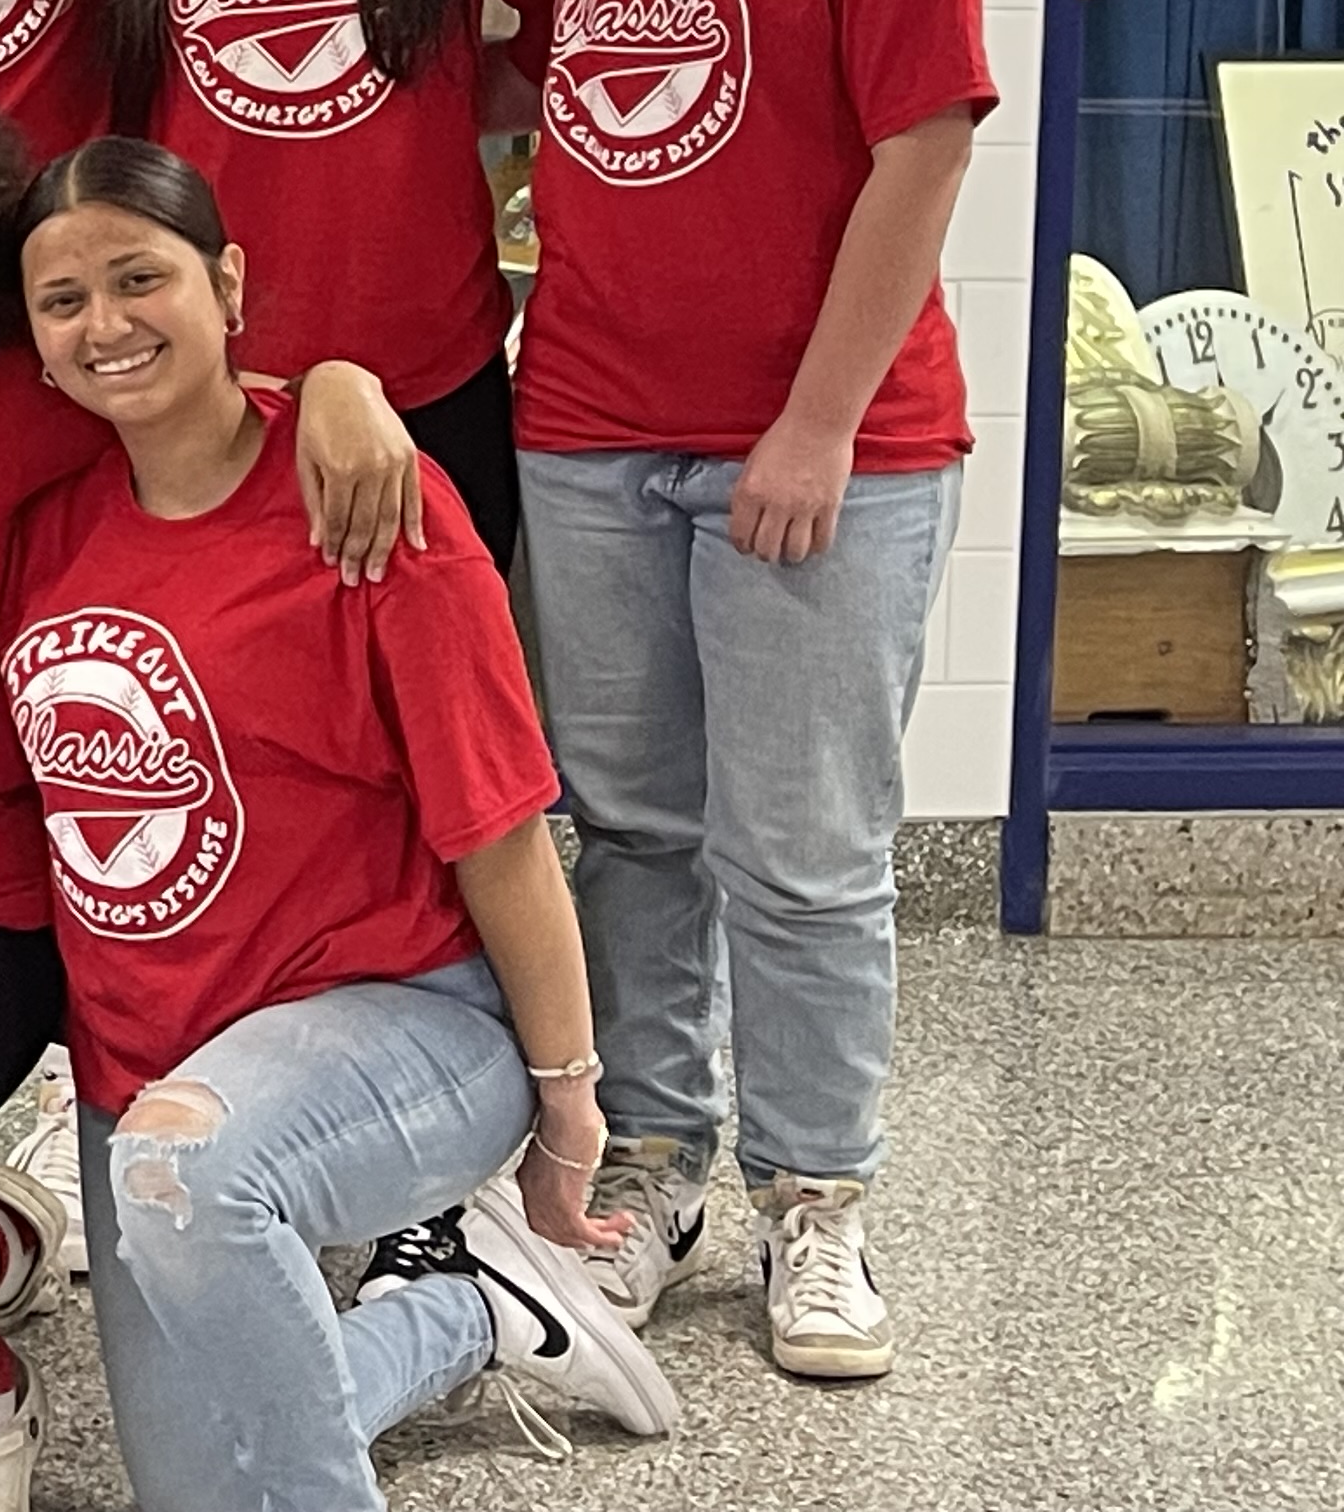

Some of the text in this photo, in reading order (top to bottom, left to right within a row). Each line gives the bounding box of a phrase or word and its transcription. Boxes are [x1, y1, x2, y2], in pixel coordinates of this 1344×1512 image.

[184, 45, 219, 88] LOU
[214, 88, 335, 127] GEHRIG'S
[1185, 319, 1216, 364] 12
[1251, 328, 1267, 369] 1
[1296, 366, 1324, 409] 2
[1328, 431, 1344, 472] 3
[7, 620, 197, 723] STRIKE OUT
[149, 816, 229, 922] DISEASE
